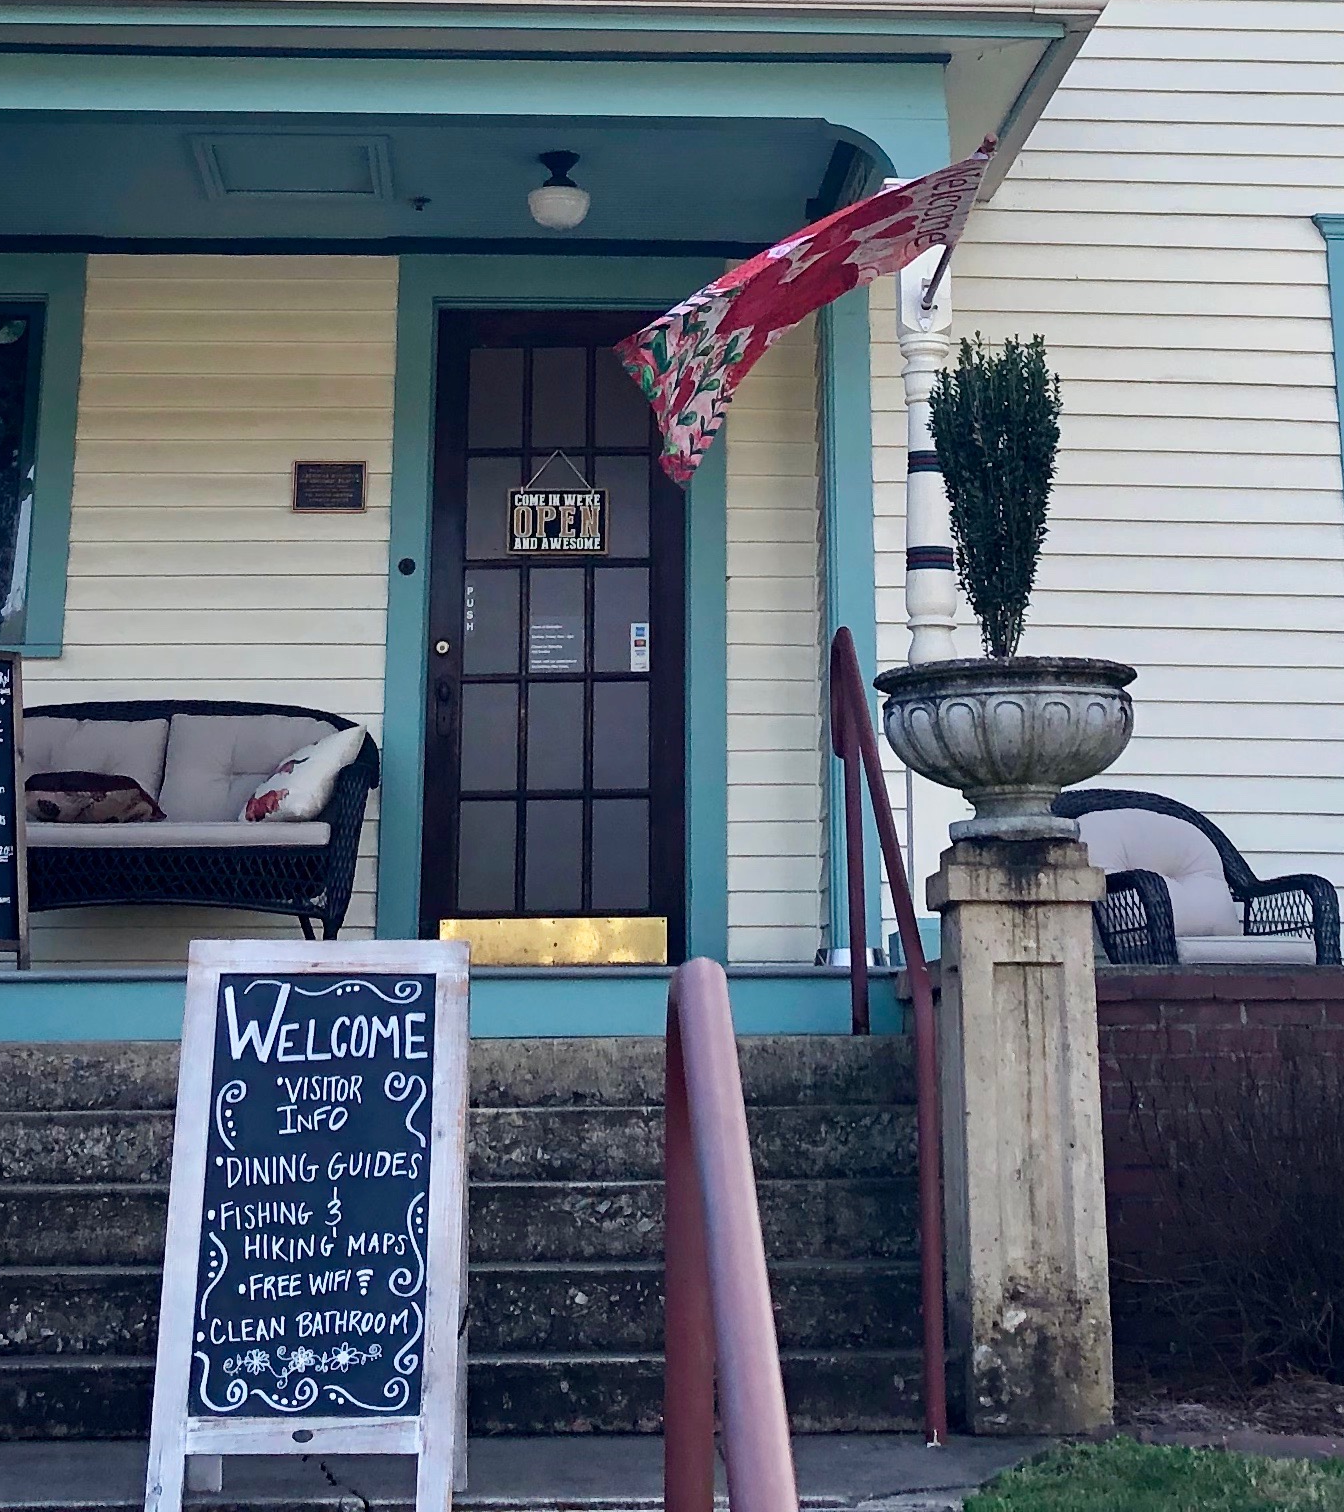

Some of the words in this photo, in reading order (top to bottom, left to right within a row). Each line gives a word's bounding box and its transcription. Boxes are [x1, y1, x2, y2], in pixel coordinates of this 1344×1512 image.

[914, 162, 982, 248] Welcome
[514, 494, 546, 506] COME
[548, 494, 560, 506] IN
[513, 506, 601, 538] OPEN
[513, 537, 538, 550] AND
[541, 537, 601, 550] AWESOME
[466, 586, 474, 631] PUSH
[224, 983, 429, 1063] WELCOME
[285, 1075, 363, 1104] VISITOR
[276, 1105, 349, 1135] INFO
[226, 1153, 319, 1188] DINING
[327, 1150, 423, 1181] GUIDES
[220, 1201, 313, 1230] FISHING
[244, 1233, 334, 1263] HIKING
[347, 1232, 409, 1257] MAPS
[249, 1273, 302, 1301] FREE
[309, 1269, 351, 1295] WIFI
[209, 1315, 286, 1345] CLEAN
[295, 1308, 409, 1338] BATHROOM
